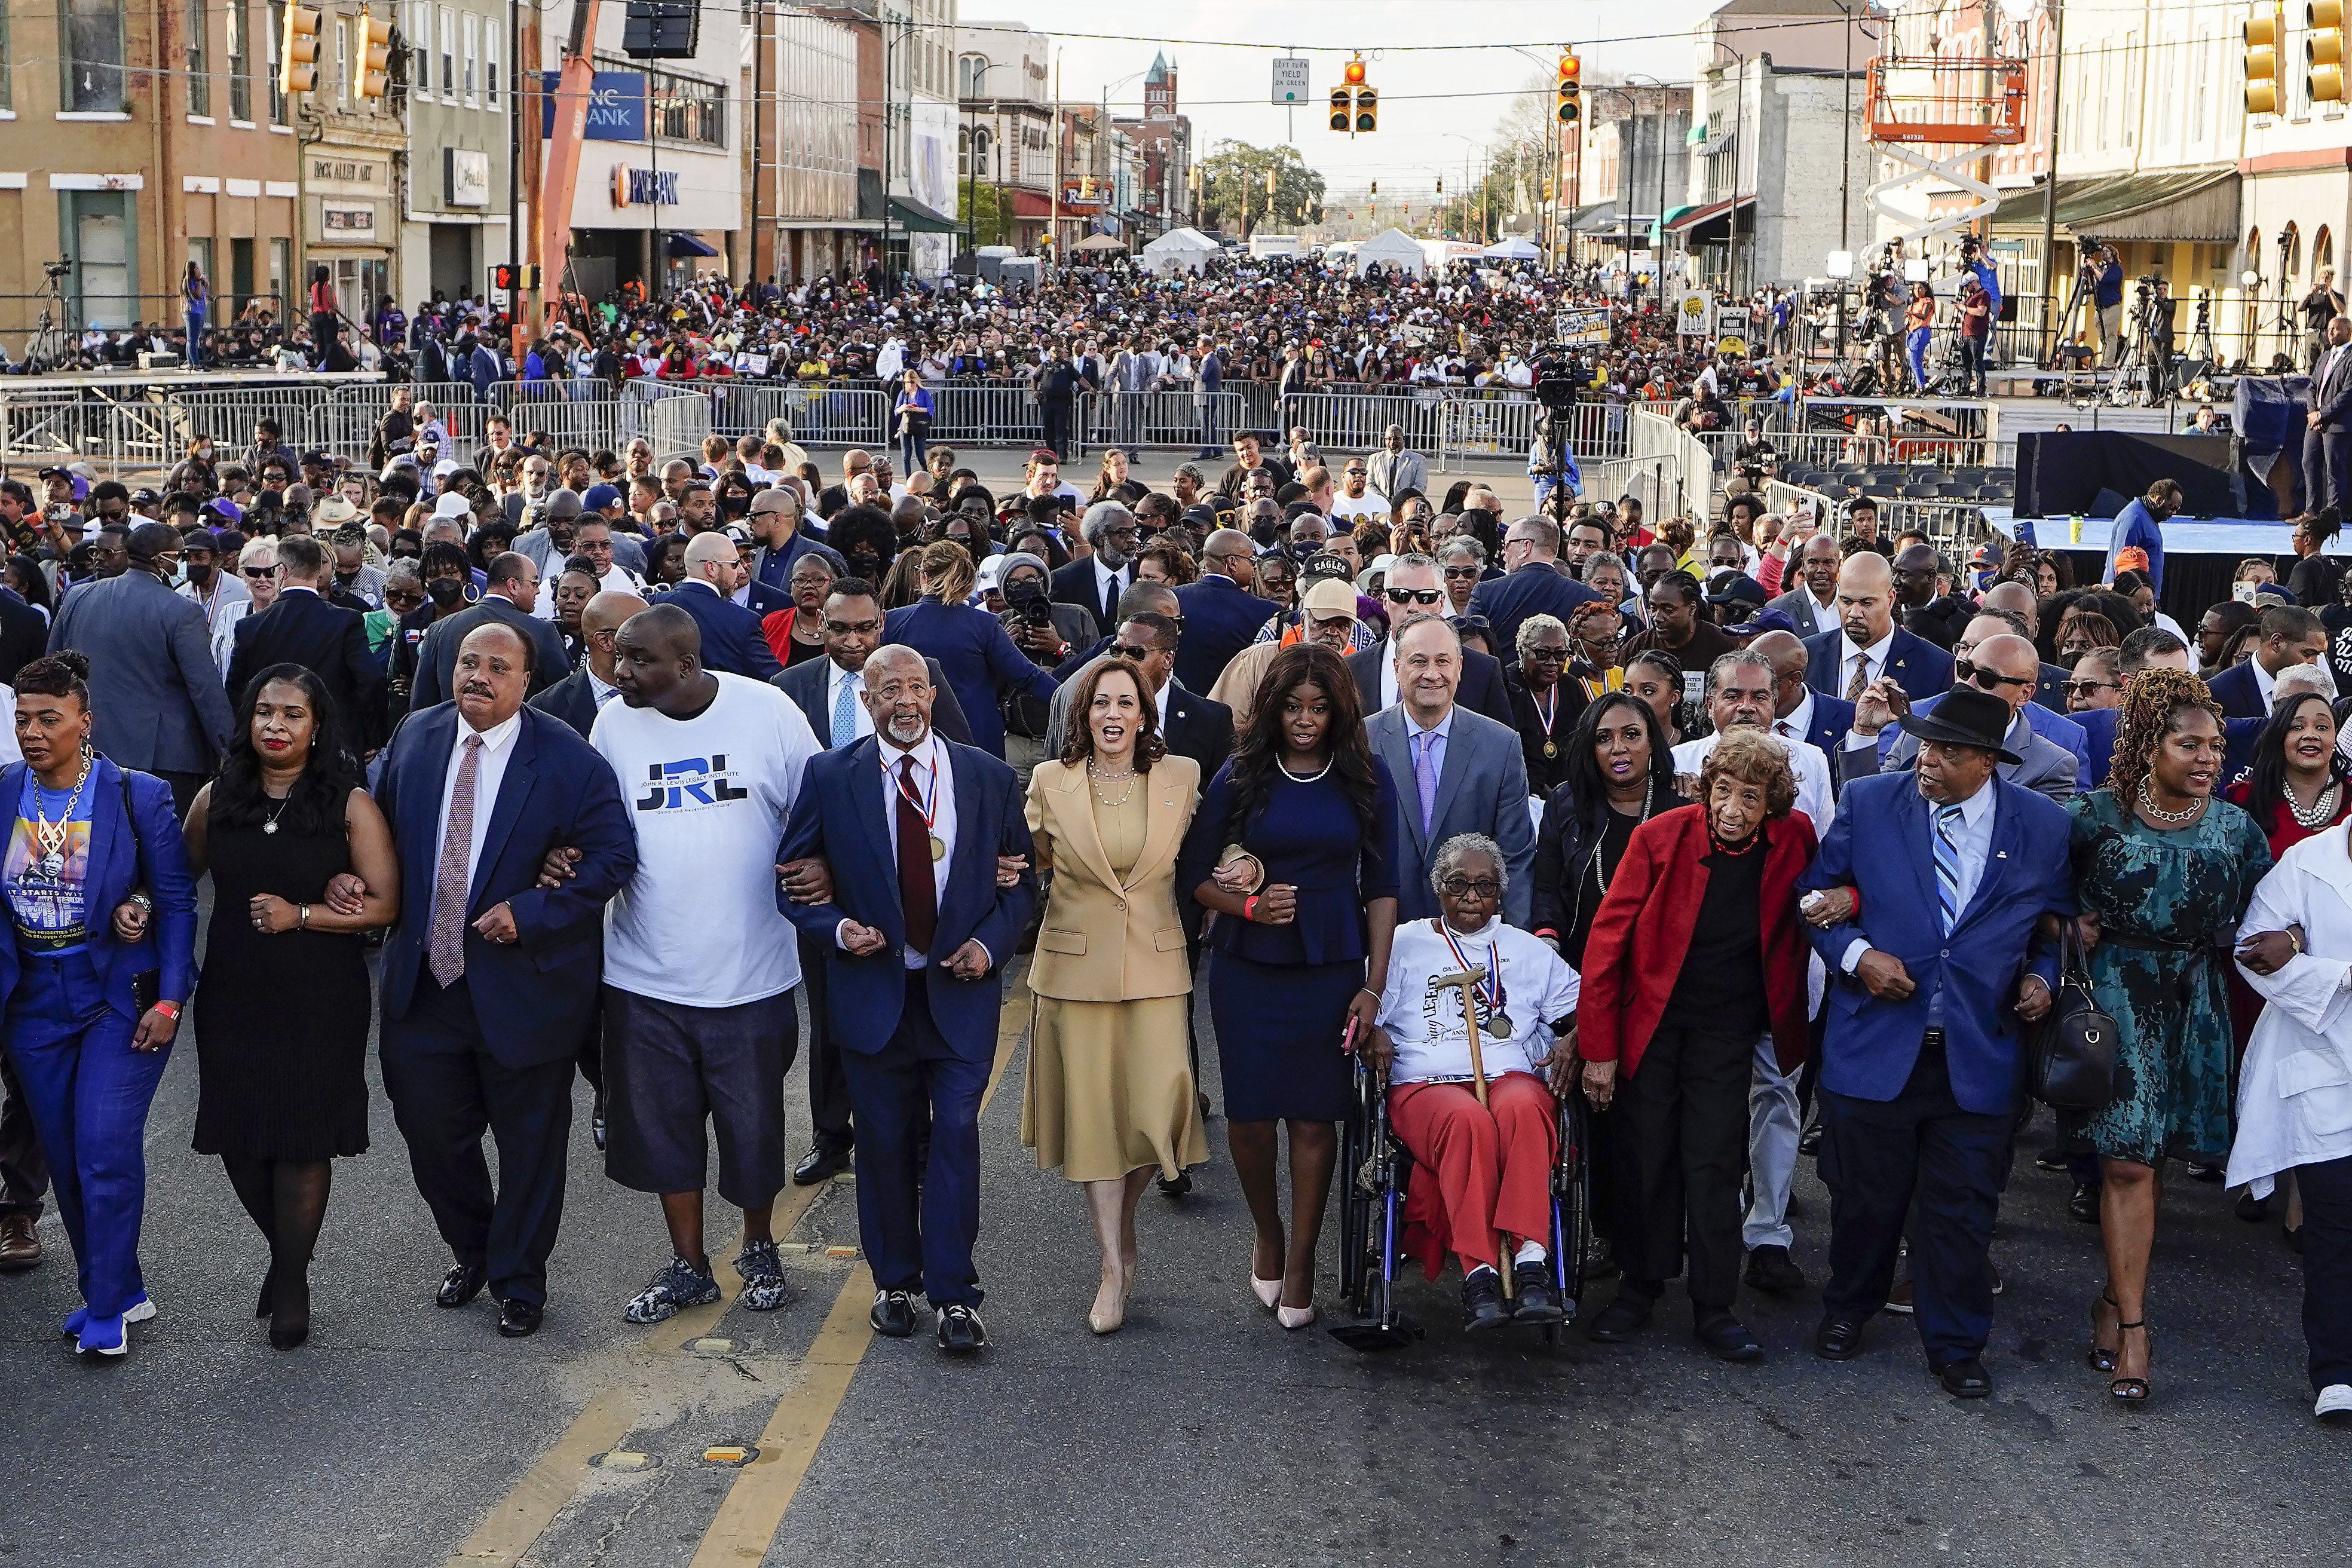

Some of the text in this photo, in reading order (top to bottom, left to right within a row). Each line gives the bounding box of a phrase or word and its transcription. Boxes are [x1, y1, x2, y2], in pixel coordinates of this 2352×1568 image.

[589, 88, 619, 106] NC
[587, 108, 631, 125] ANK
[1585, 319, 1608, 332] VOTE
[1724, 318, 1740, 327] FIGHT
[1721, 327, 1745, 336] POVERTY
[1314, 560, 1346, 574] EAGLES
[636, 754, 747, 810] JRL
[685, 774, 707, 783] LEGACY
